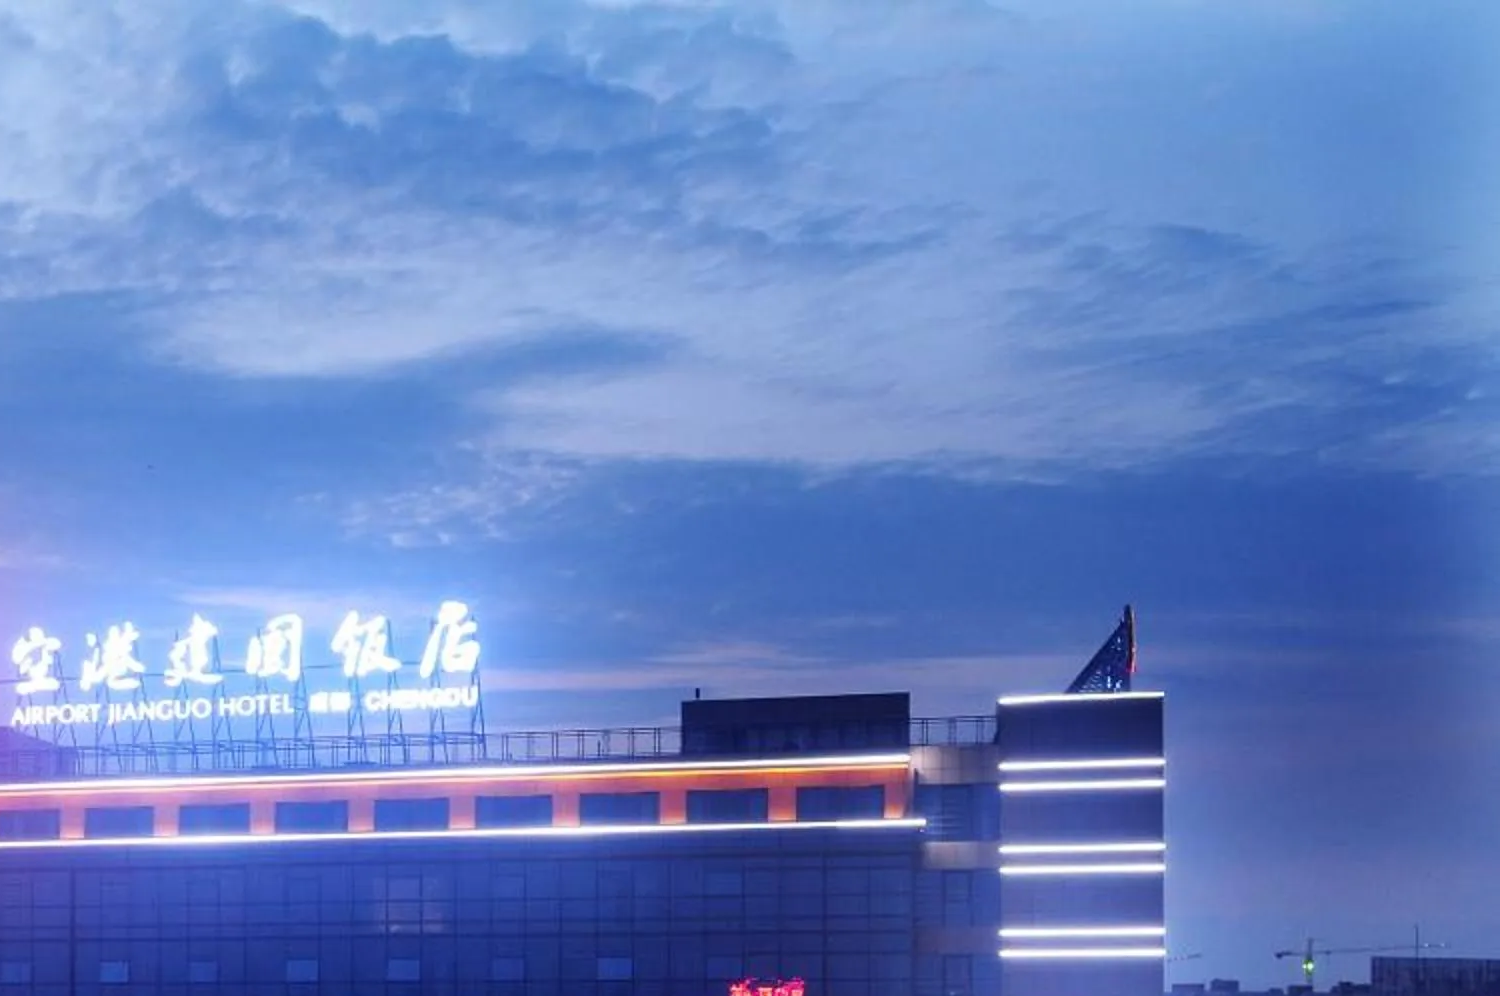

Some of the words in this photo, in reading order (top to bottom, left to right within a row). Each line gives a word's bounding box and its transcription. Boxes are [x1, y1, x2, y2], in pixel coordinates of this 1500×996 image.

[11, 703, 101, 726] AIRPORT
[107, 698, 212, 726] JIANGUO
[218, 694, 295, 716] HOTEL
